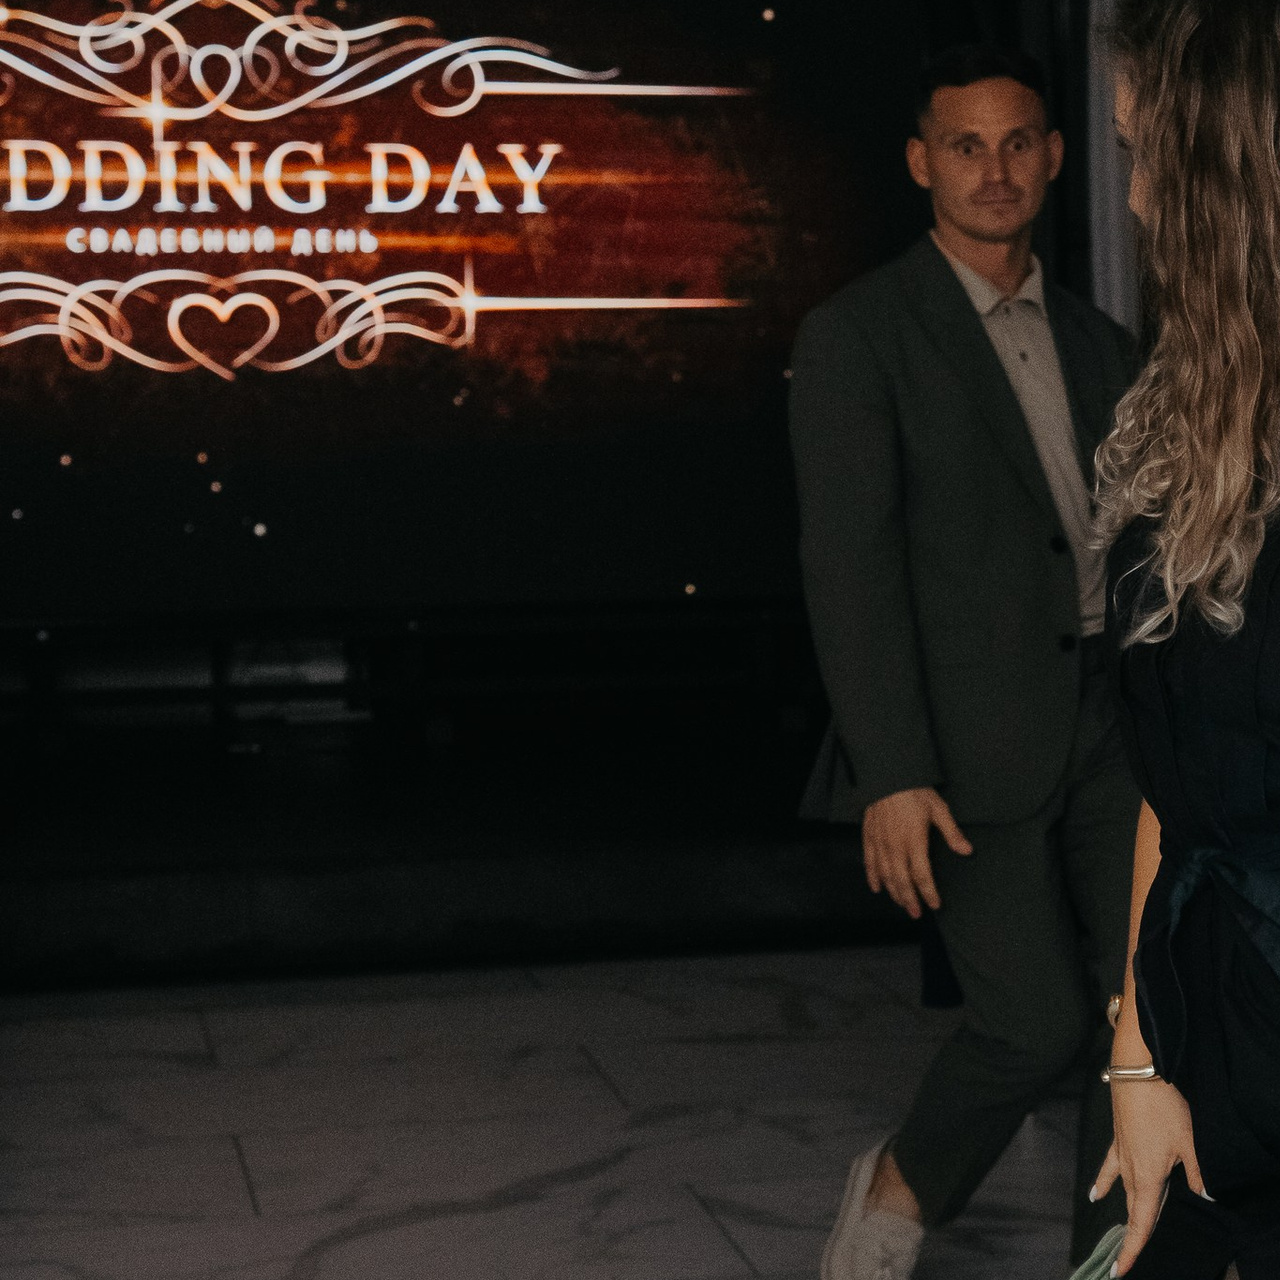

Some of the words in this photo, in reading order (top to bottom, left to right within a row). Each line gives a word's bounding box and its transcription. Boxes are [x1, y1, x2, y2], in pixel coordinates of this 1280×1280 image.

[0, 139, 334, 214] DDING
[363, 142, 564, 214] DAY
[290, 227, 379, 256] ДЕНЬ
